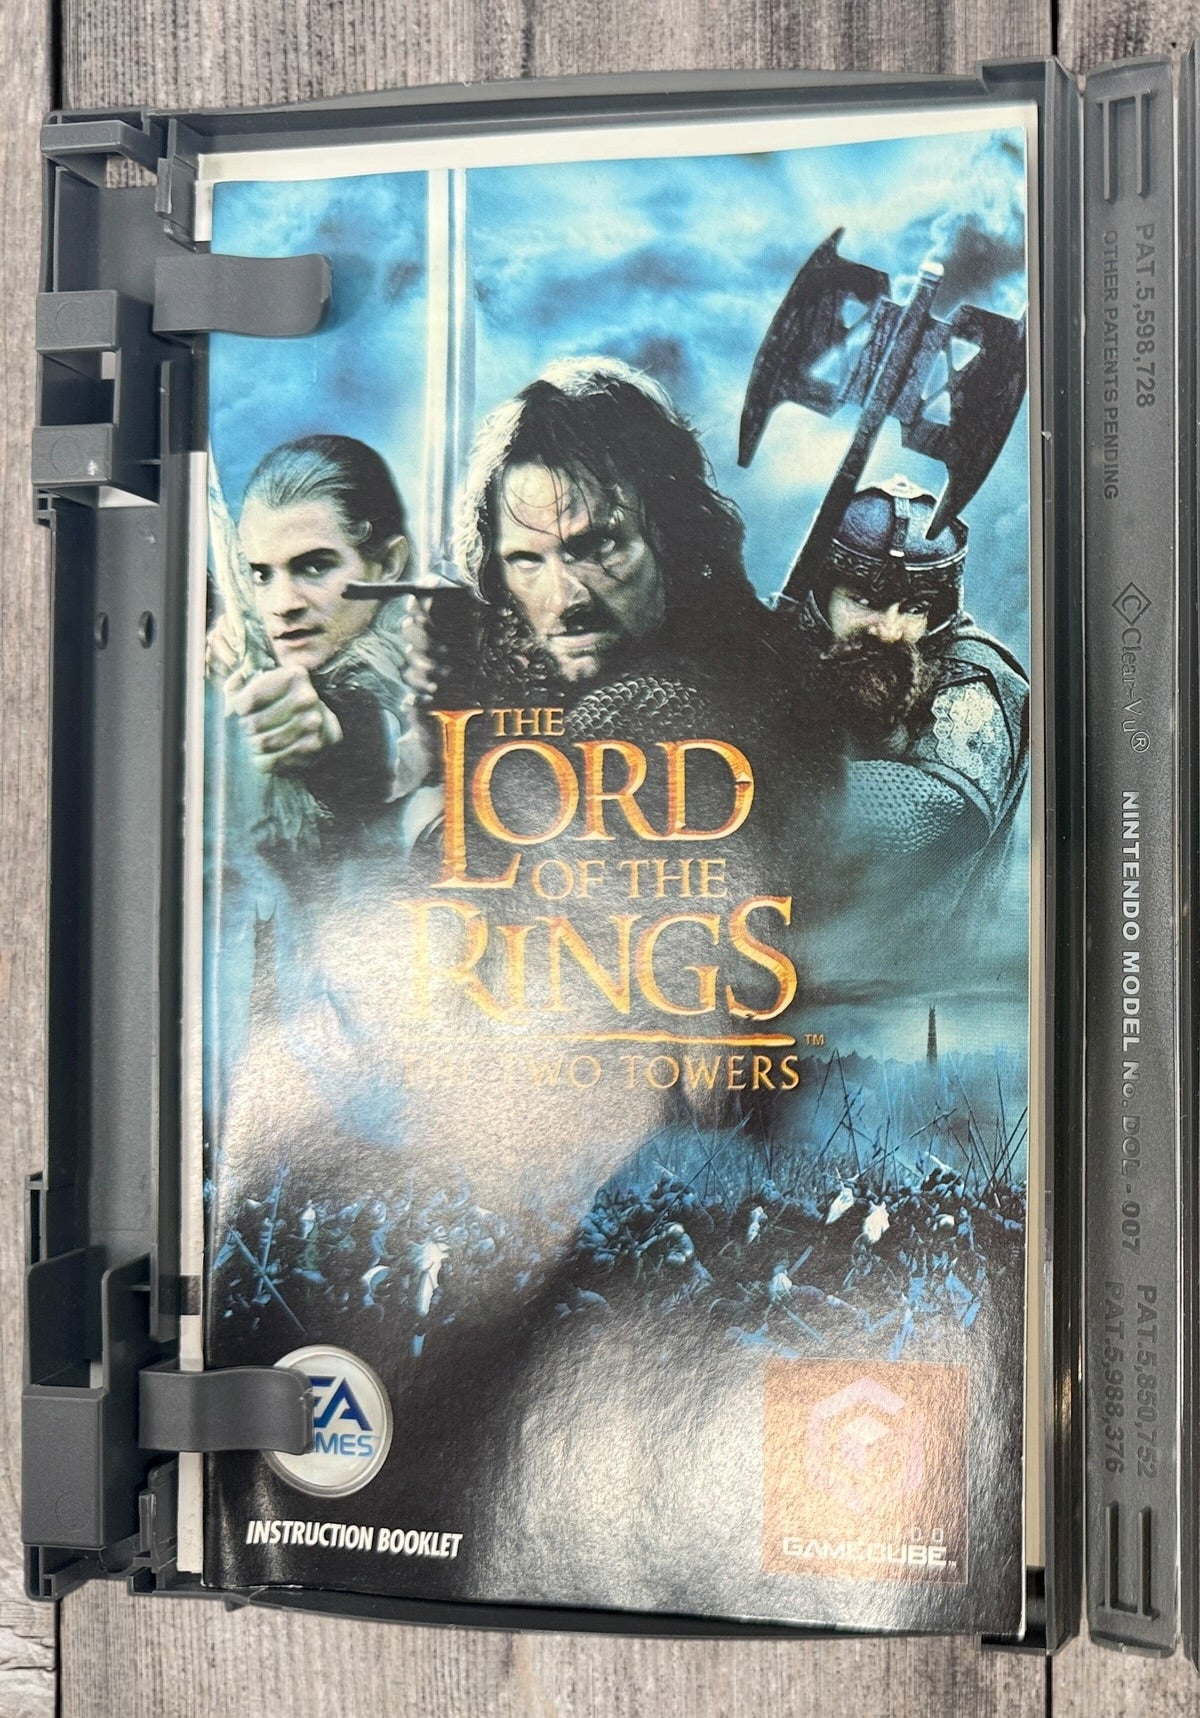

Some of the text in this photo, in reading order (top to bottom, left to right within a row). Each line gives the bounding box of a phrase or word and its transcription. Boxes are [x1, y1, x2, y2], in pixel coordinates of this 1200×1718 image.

[1103, 230, 1118, 500] OTHER PATENTS PENDING
[492, 708, 566, 737] THE
[430, 709, 755, 889] LORD
[532, 858, 728, 900] OF THE
[1122, 791, 1140, 941] NINTENDO
[400, 895, 798, 1025] RINGS
[1122, 951, 1140, 1052] MODEL
[619, 1055, 800, 1091] TOWERS
[1122, 1061, 1140, 1108] No.
[312, 1431, 373, 1457] MES
[246, 1520, 463, 1560] INSTRUCTION BOOKLET
[782, 1536, 947, 1568] GAMECUBE
